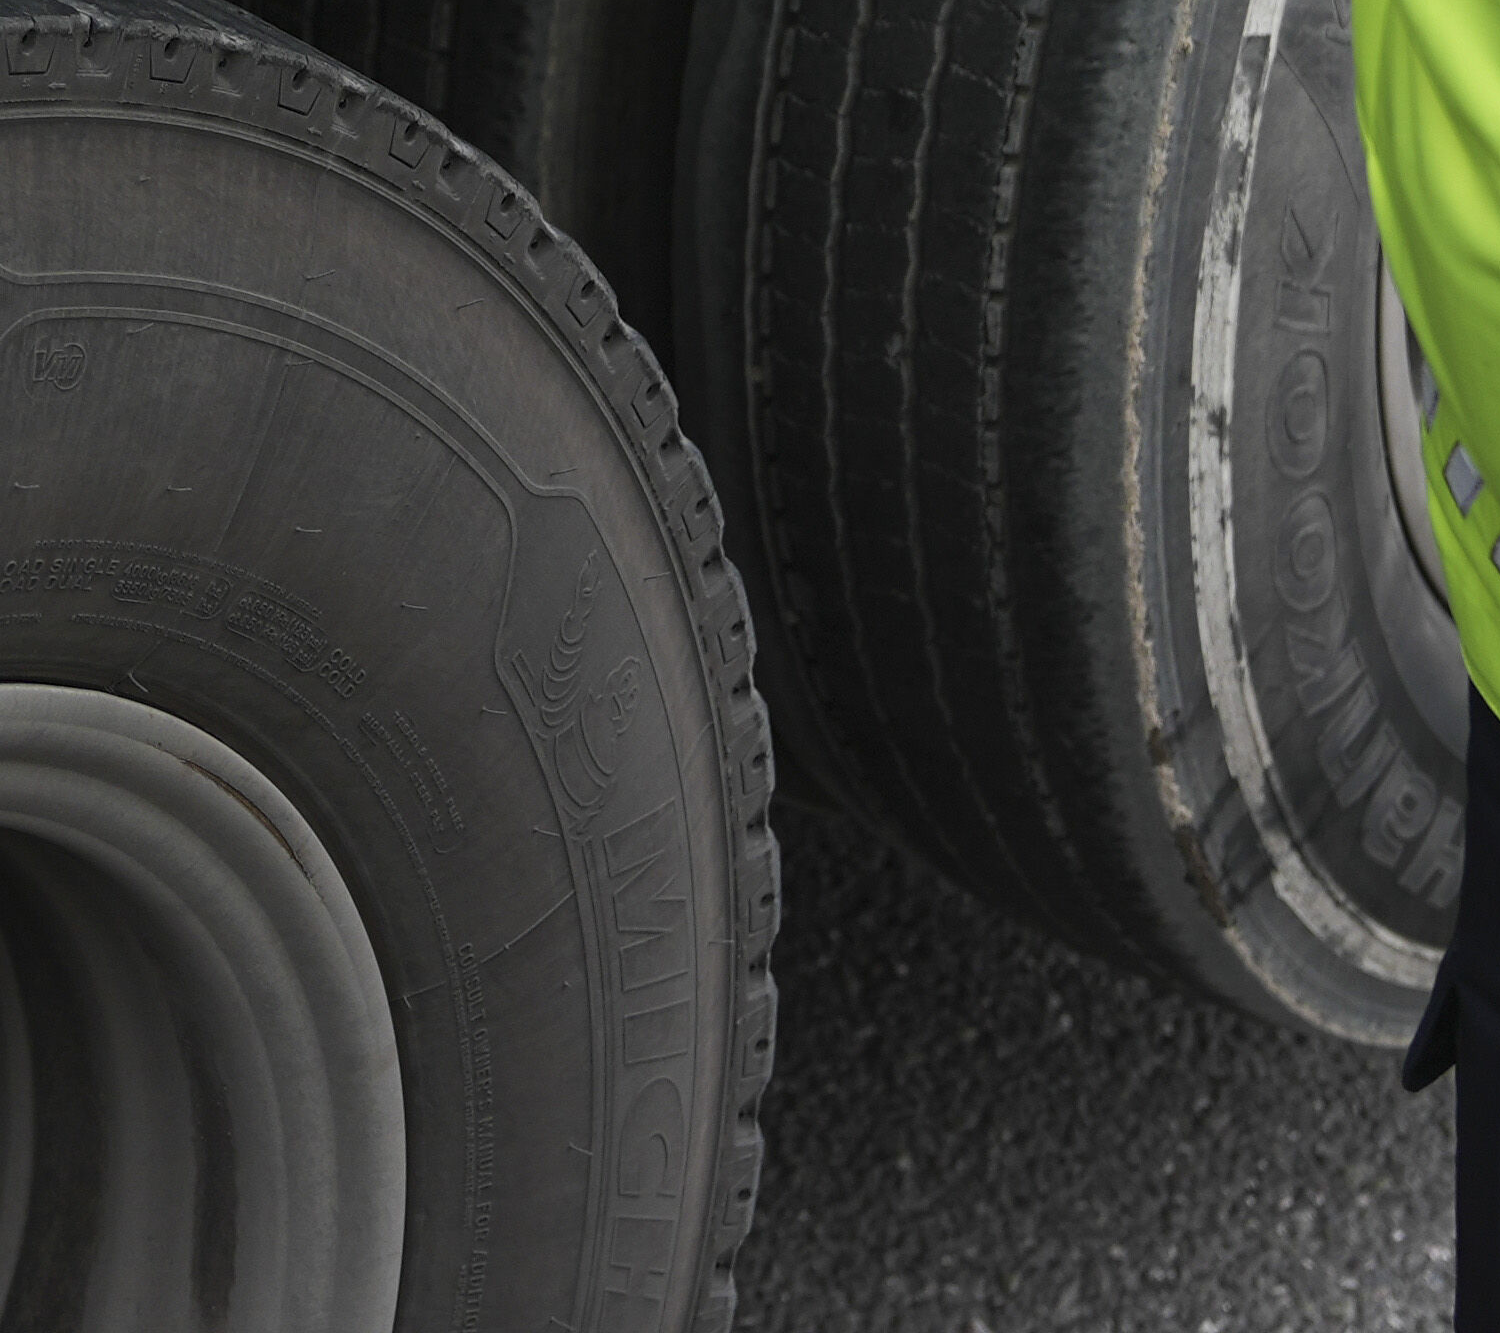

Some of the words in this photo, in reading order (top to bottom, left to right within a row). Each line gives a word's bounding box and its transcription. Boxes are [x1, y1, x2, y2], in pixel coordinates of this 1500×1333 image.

[50, 556, 120, 578] SINGLE
[329, 647, 368, 685] COLD
[317, 662, 357, 701] COLD
[458, 941, 490, 1022] CONSULT
[472, 1027, 494, 1112] OWNER'S
[474, 1111, 496, 1198] MANUAL
